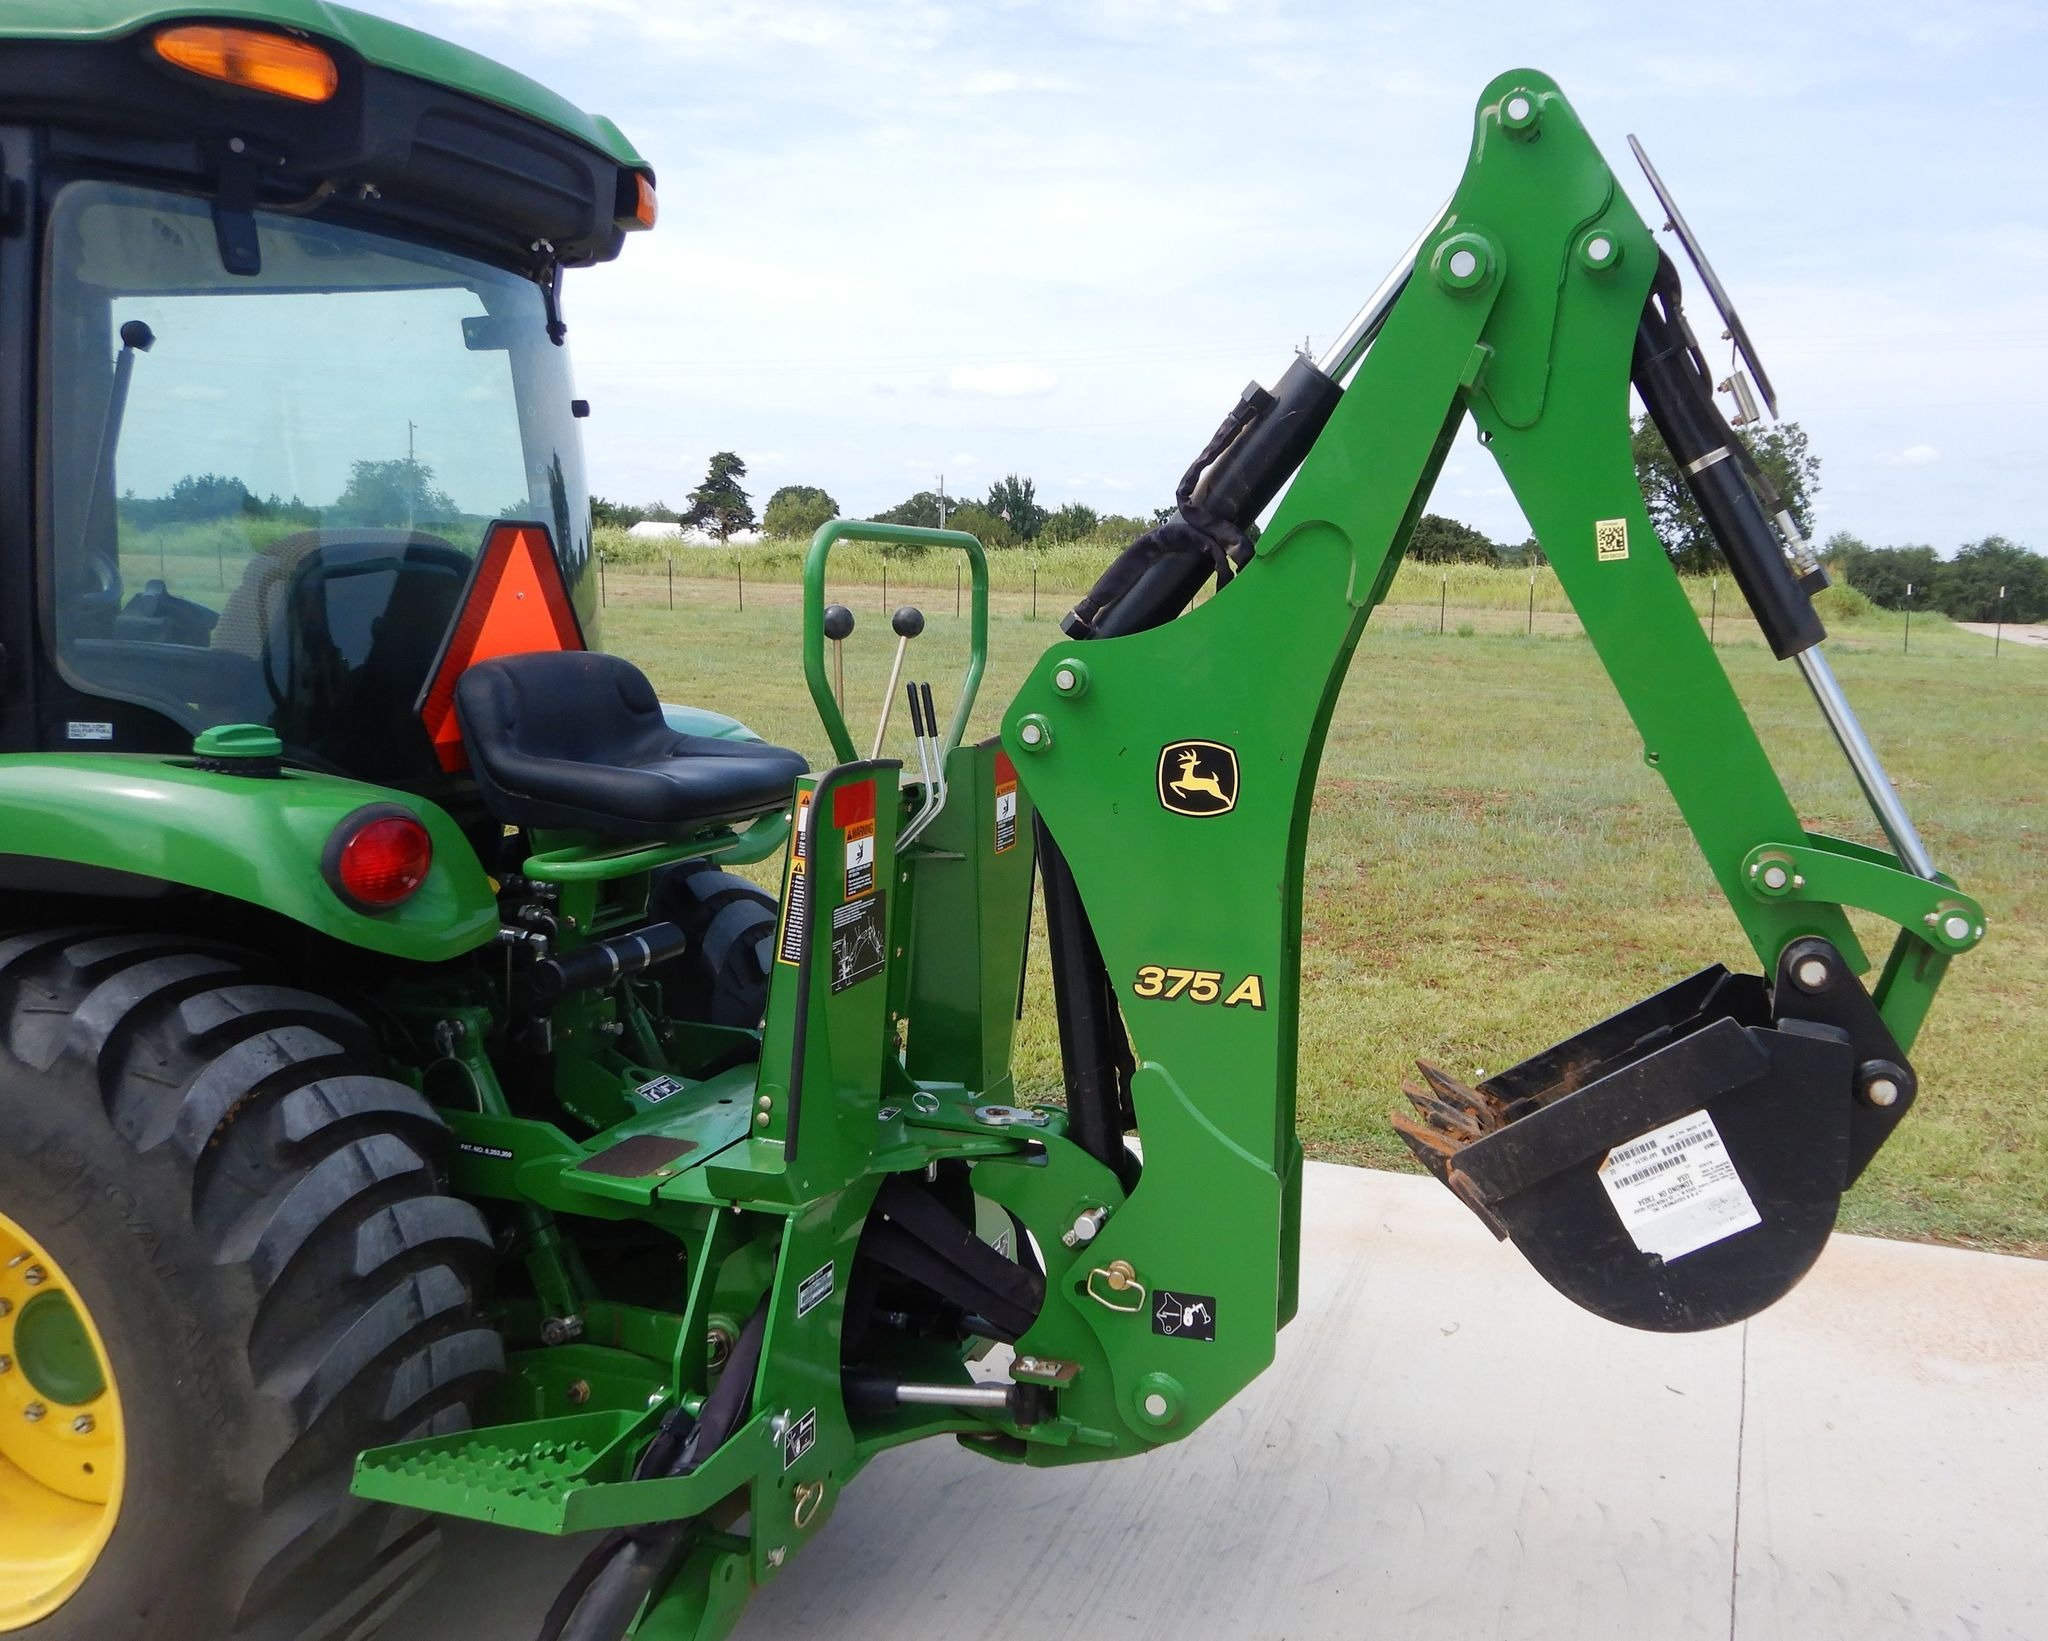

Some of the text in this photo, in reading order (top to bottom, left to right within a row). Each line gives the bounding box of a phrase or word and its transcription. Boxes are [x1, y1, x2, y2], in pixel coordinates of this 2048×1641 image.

[1676, 1172, 1690, 1183] USA
[1666, 1178, 1693, 1195] EDMOND
[1657, 1190, 1667, 1198] OK
